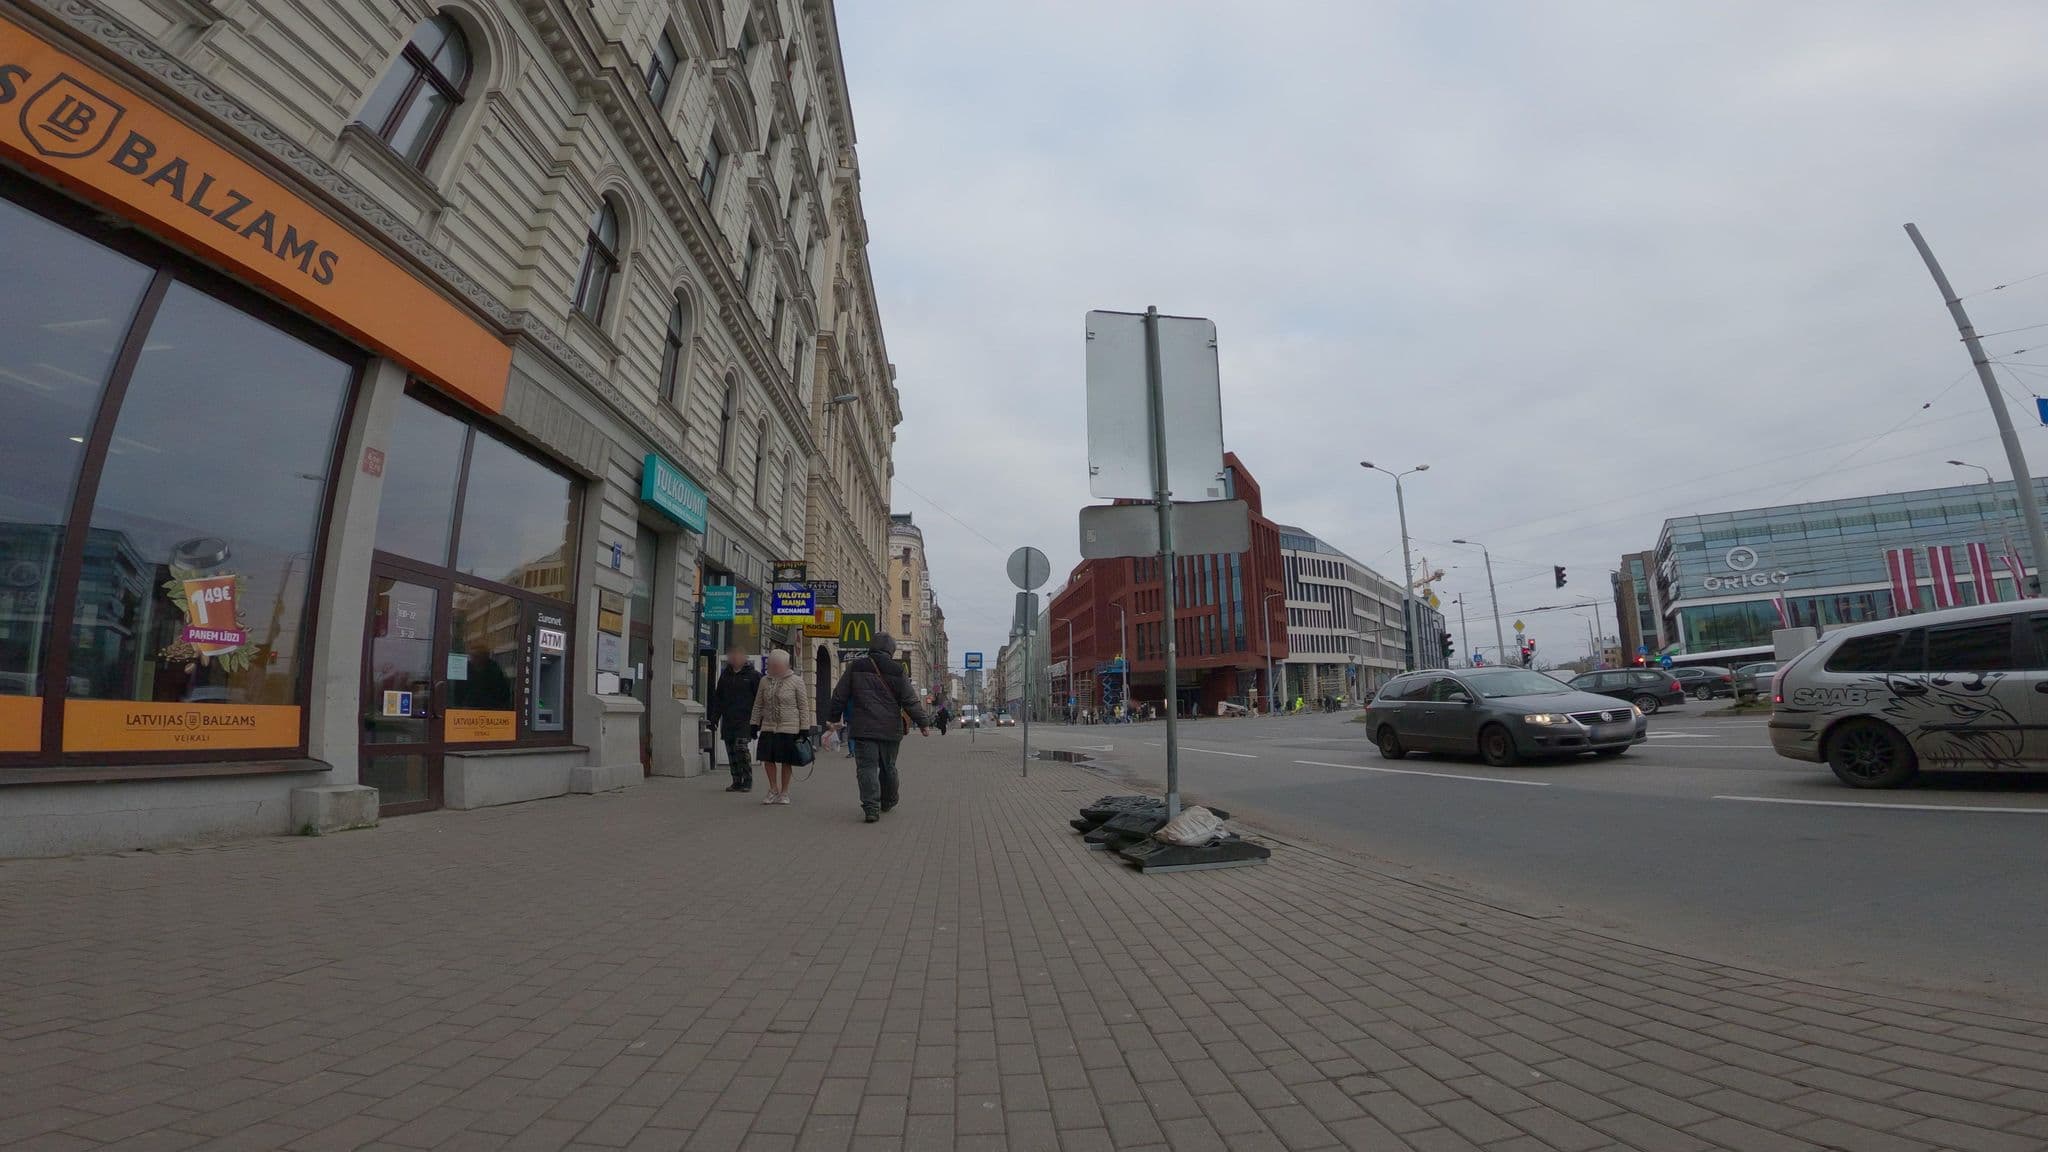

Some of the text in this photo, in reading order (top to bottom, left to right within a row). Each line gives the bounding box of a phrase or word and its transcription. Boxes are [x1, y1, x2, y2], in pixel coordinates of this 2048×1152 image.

[108, 129, 338, 285] BALZAMS
[1703, 570, 1789, 591] ORIGO
[782, 599, 807, 607] MAIŅA
[538, 612, 562, 626] Euronet
[189, 629, 240, 642] PAŅEM LĪDZI
[541, 632, 562, 648] ATM
[1793, 688, 1868, 706] SAAB
[126, 714, 183, 728] LATVIJAS
[203, 715, 256, 727] BALZAMS
[174, 734, 210, 743] VEIKALI
